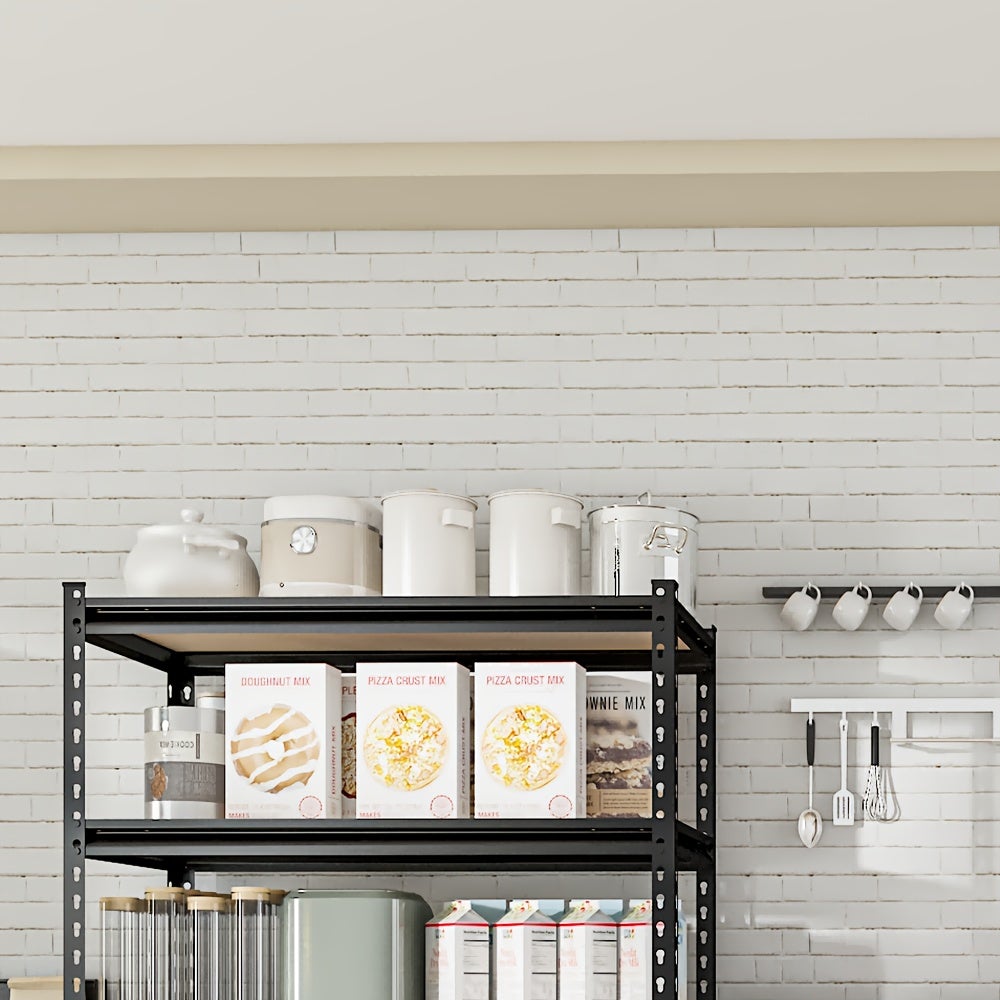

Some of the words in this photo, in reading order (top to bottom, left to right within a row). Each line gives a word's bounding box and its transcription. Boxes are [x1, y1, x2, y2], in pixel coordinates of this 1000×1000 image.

[241, 676, 291, 687] DOUGHNUT
[293, 676, 311, 686] MIX
[368, 676, 393, 686] PIZZA
[396, 676, 425, 686] CRUST
[429, 676, 446, 686] MIX
[486, 675, 512, 685] PIZZA
[514, 675, 544, 685] CRUST
[547, 675, 565, 685] MIX
[625, 696, 646, 710] MIX
